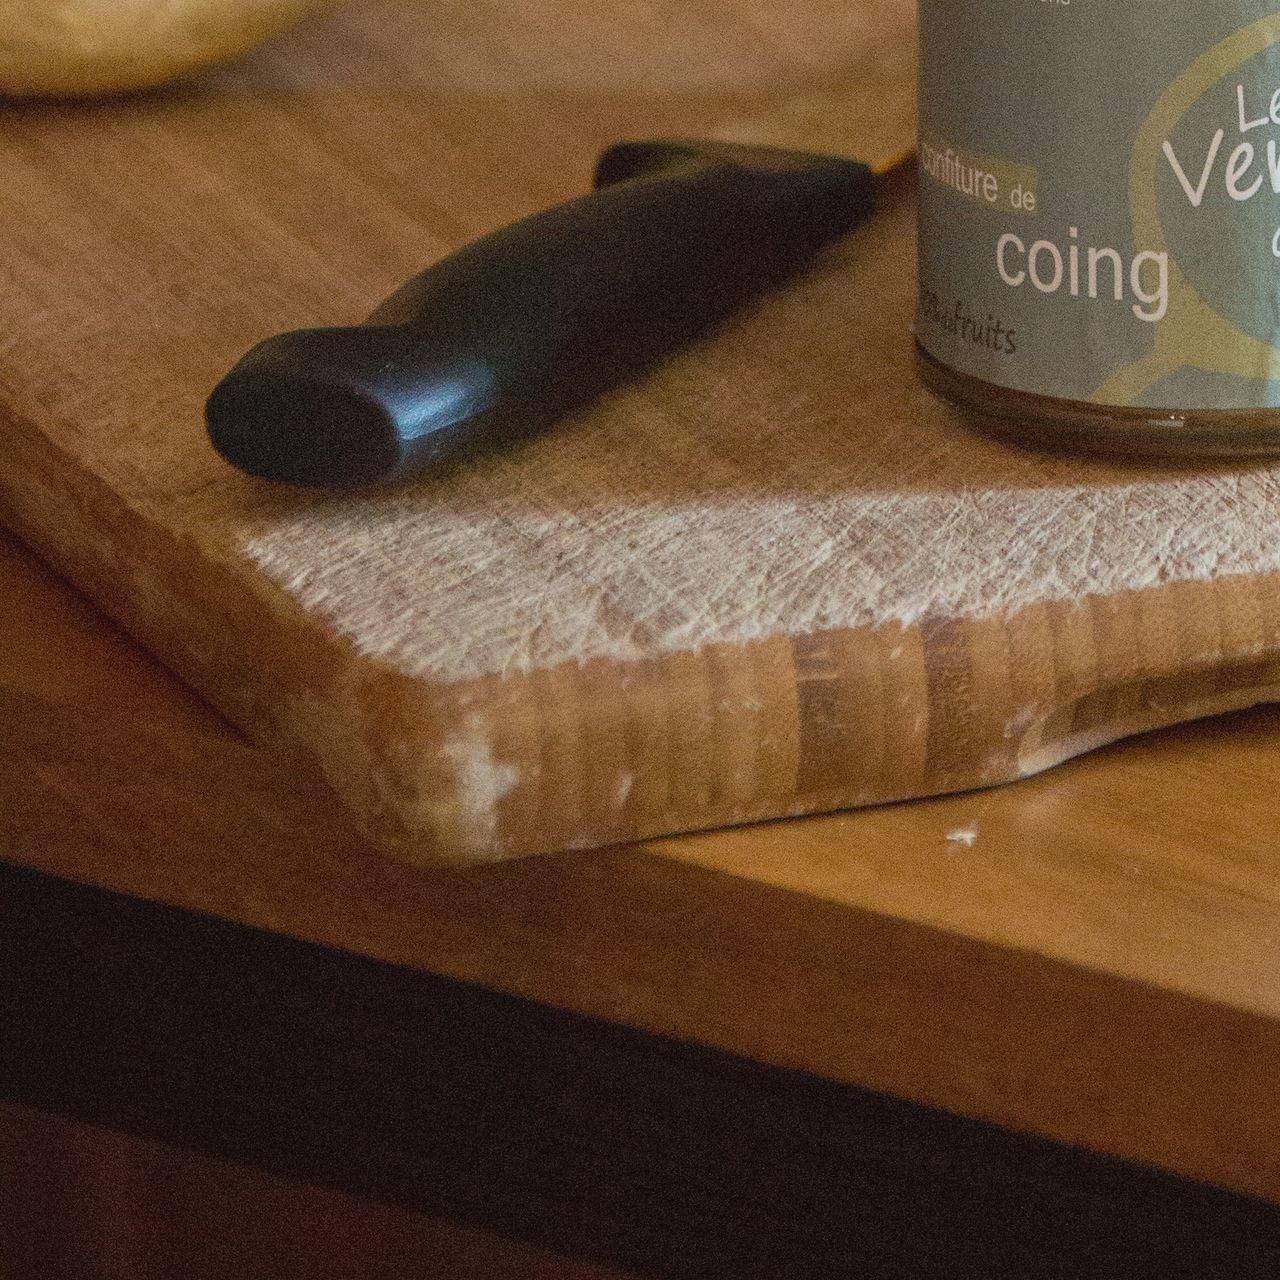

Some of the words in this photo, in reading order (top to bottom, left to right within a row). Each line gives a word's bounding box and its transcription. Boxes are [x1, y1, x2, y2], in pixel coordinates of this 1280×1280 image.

[1010, 184, 1036, 212] de
[996, 226, 1169, 323] coing
[952, 299, 1018, 356] fruits
